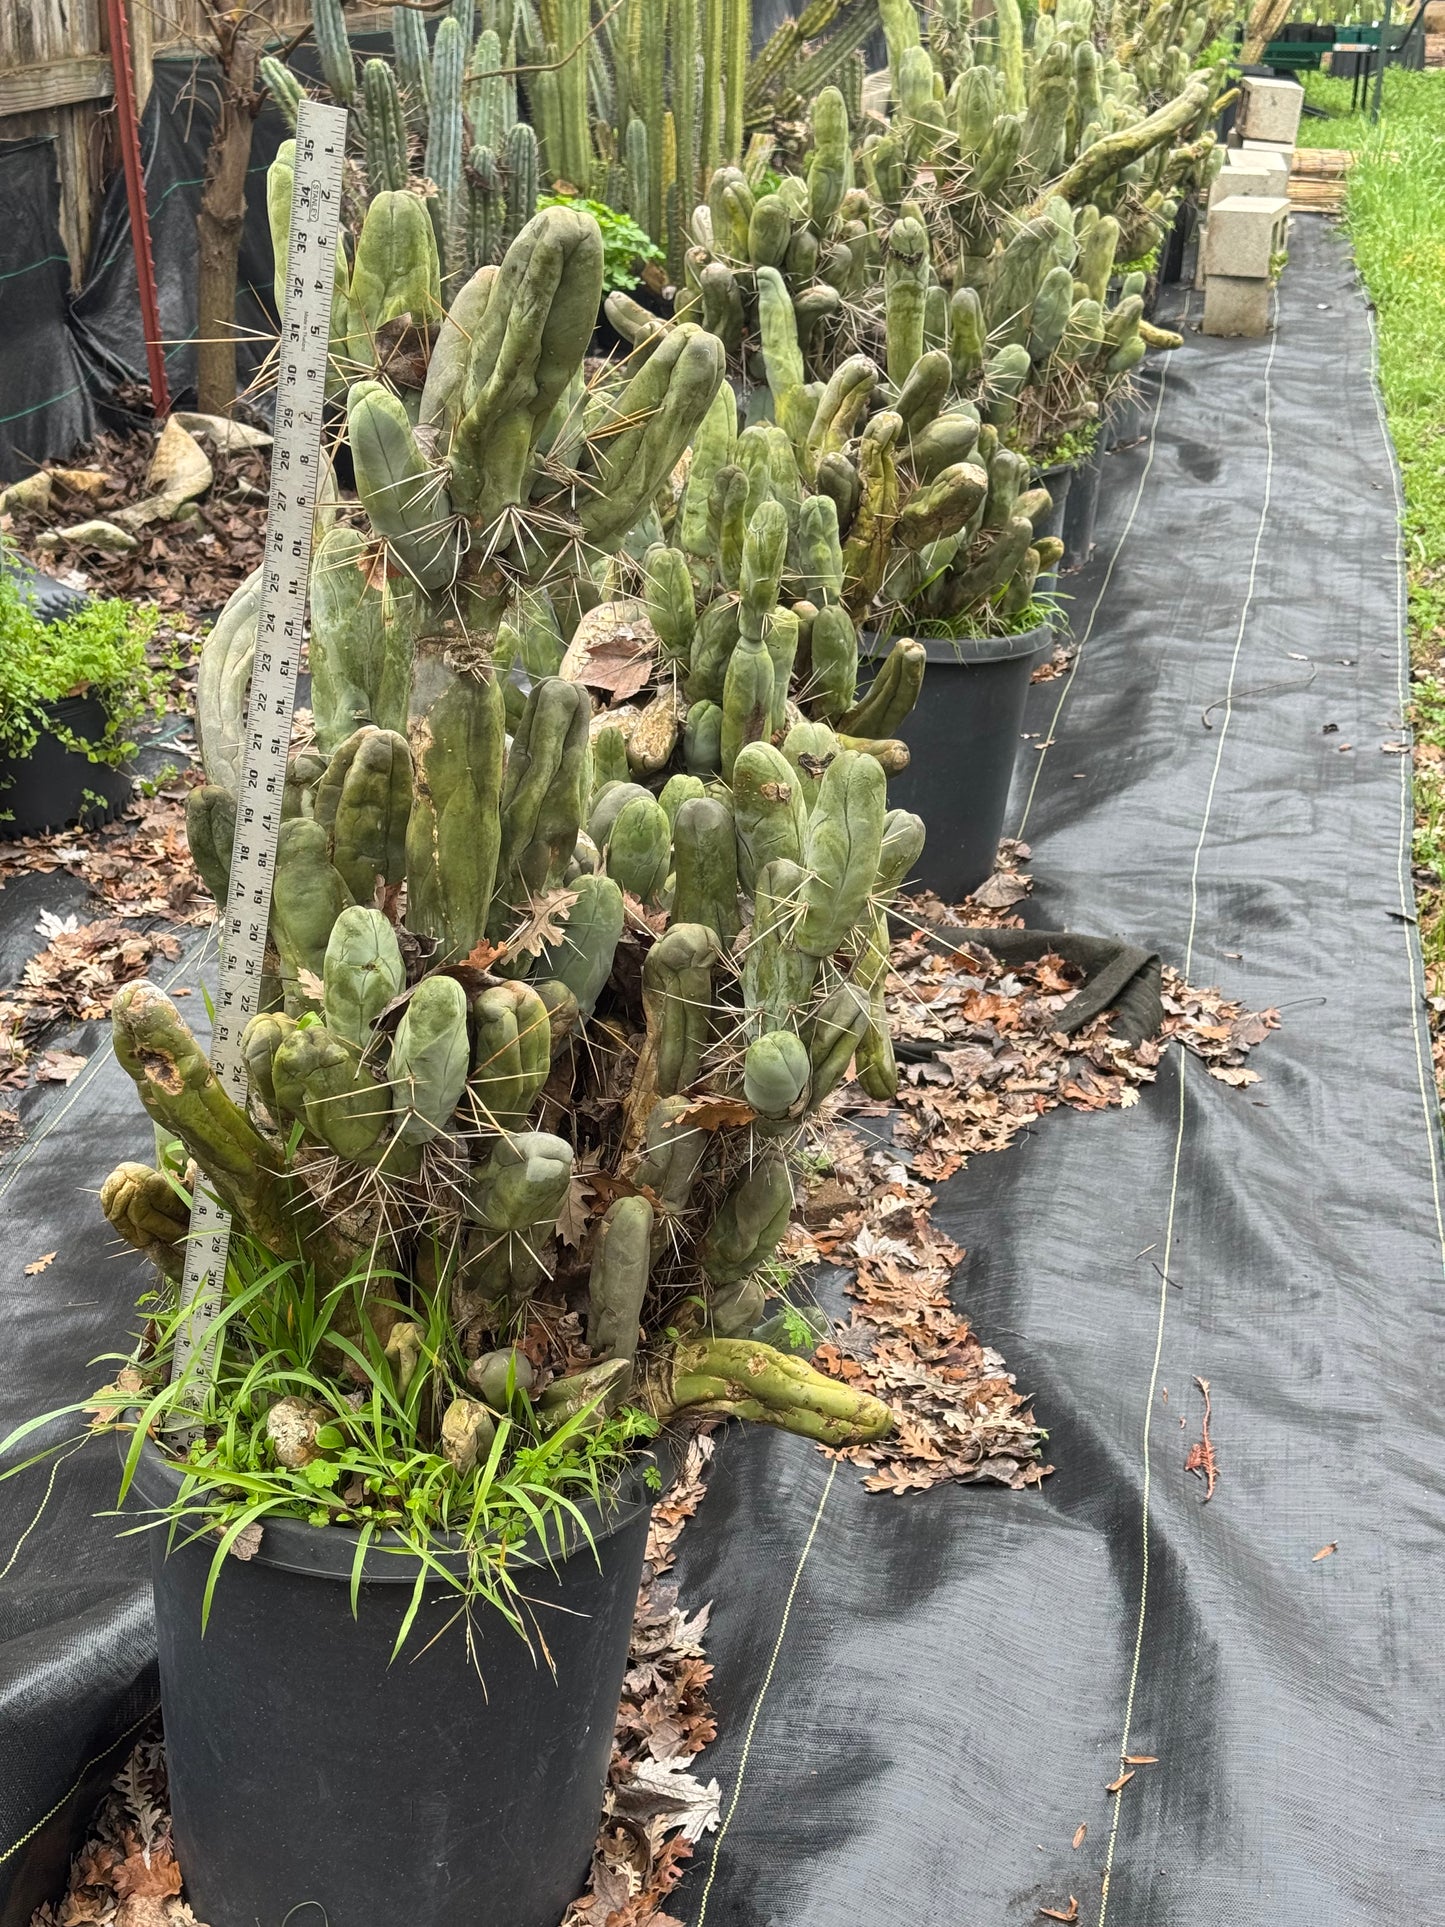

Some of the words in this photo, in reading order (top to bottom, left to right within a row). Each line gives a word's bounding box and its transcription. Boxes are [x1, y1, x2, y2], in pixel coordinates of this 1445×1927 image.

[304, 139, 314, 161] 35
[301, 186, 310, 208] 34
[310, 183, 320, 220] STANLEY
[321, 190, 331, 200] 2
[297, 232, 307, 253] 33
[318, 237, 327, 246] 3
[294, 277, 304, 298] 32
[314, 280, 324, 290] 4
[290, 323, 300, 342] 31
[311, 326, 320, 335] 5
[287, 365, 297, 385] 30
[307, 370, 316, 378] 6
[284, 408, 294, 428] 29
[303, 412, 312, 422] 7
[281, 450, 290, 470] 28
[300, 455, 309, 464] 8
[277, 492, 287, 512] 27
[296, 496, 306, 506] 9
[274, 532, 284, 552] 26
[292, 539, 302, 557] 10
[270, 573, 280, 592] 25
[288, 579, 298, 596] 11
[266, 614, 276, 632] 24
[284, 620, 294, 636] 12
[262, 653, 272, 672] 23
[280, 659, 290, 676] 13
[258, 692, 268, 712] 22
[276, 698, 285, 716] 14
[252, 733, 262, 750] 21
[271, 738, 280, 754] 15
[248, 769, 258, 788] 20
[266, 776, 276, 792] 16
[244, 808, 254, 824] 19
[262, 814, 272, 830] 17
[240, 846, 250, 861] 18
[258, 852, 268, 868] 18
[236, 882, 246, 898] 17
[254, 889, 263, 904] 19
[232, 920, 242, 934] 16
[250, 924, 258, 942] 20
[228, 956, 238, 970] 15
[245, 960, 254, 976] 21
[224, 992, 233, 1006] 14
[240, 995, 250, 1012] 22
[220, 1027, 228, 1042] 13
[216, 1062, 224, 1076] 12
[232, 1066, 242, 1083] 24
[199, 1206, 208, 1216] 8
[194, 1240, 203, 1248] 7
[212, 1236, 221, 1254] 29
[190, 1274, 199, 1282] 6
[208, 1270, 216, 1286] 30
[204, 1302, 212, 1318] 31
[183, 1340, 191, 1348] 4
